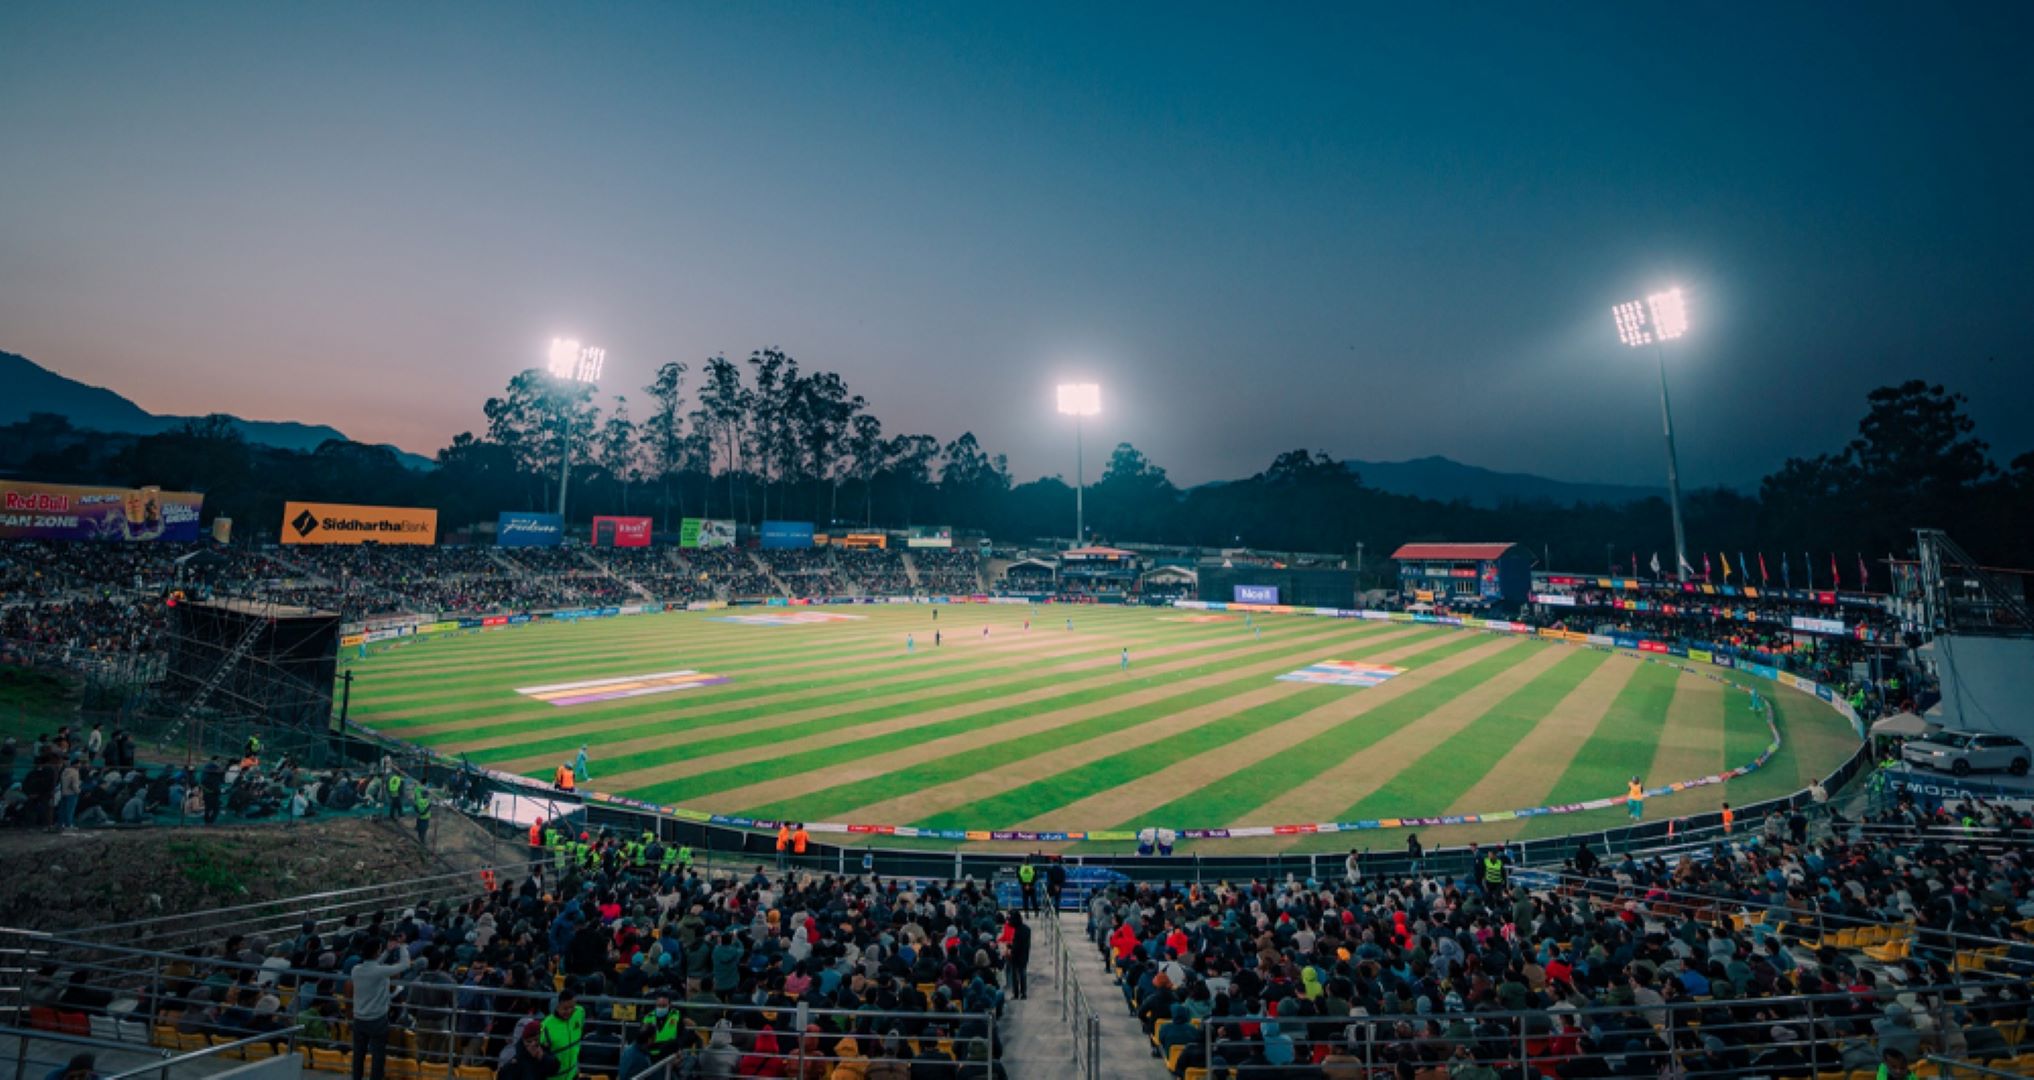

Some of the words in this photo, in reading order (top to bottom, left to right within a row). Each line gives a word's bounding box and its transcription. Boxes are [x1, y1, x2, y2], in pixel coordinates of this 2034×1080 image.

[7, 491, 36, 509] Red
[39, 494, 68, 511] Bull
[34, 514, 79, 527] ZONE
[322, 518, 429, 532] SiddharthaBank
